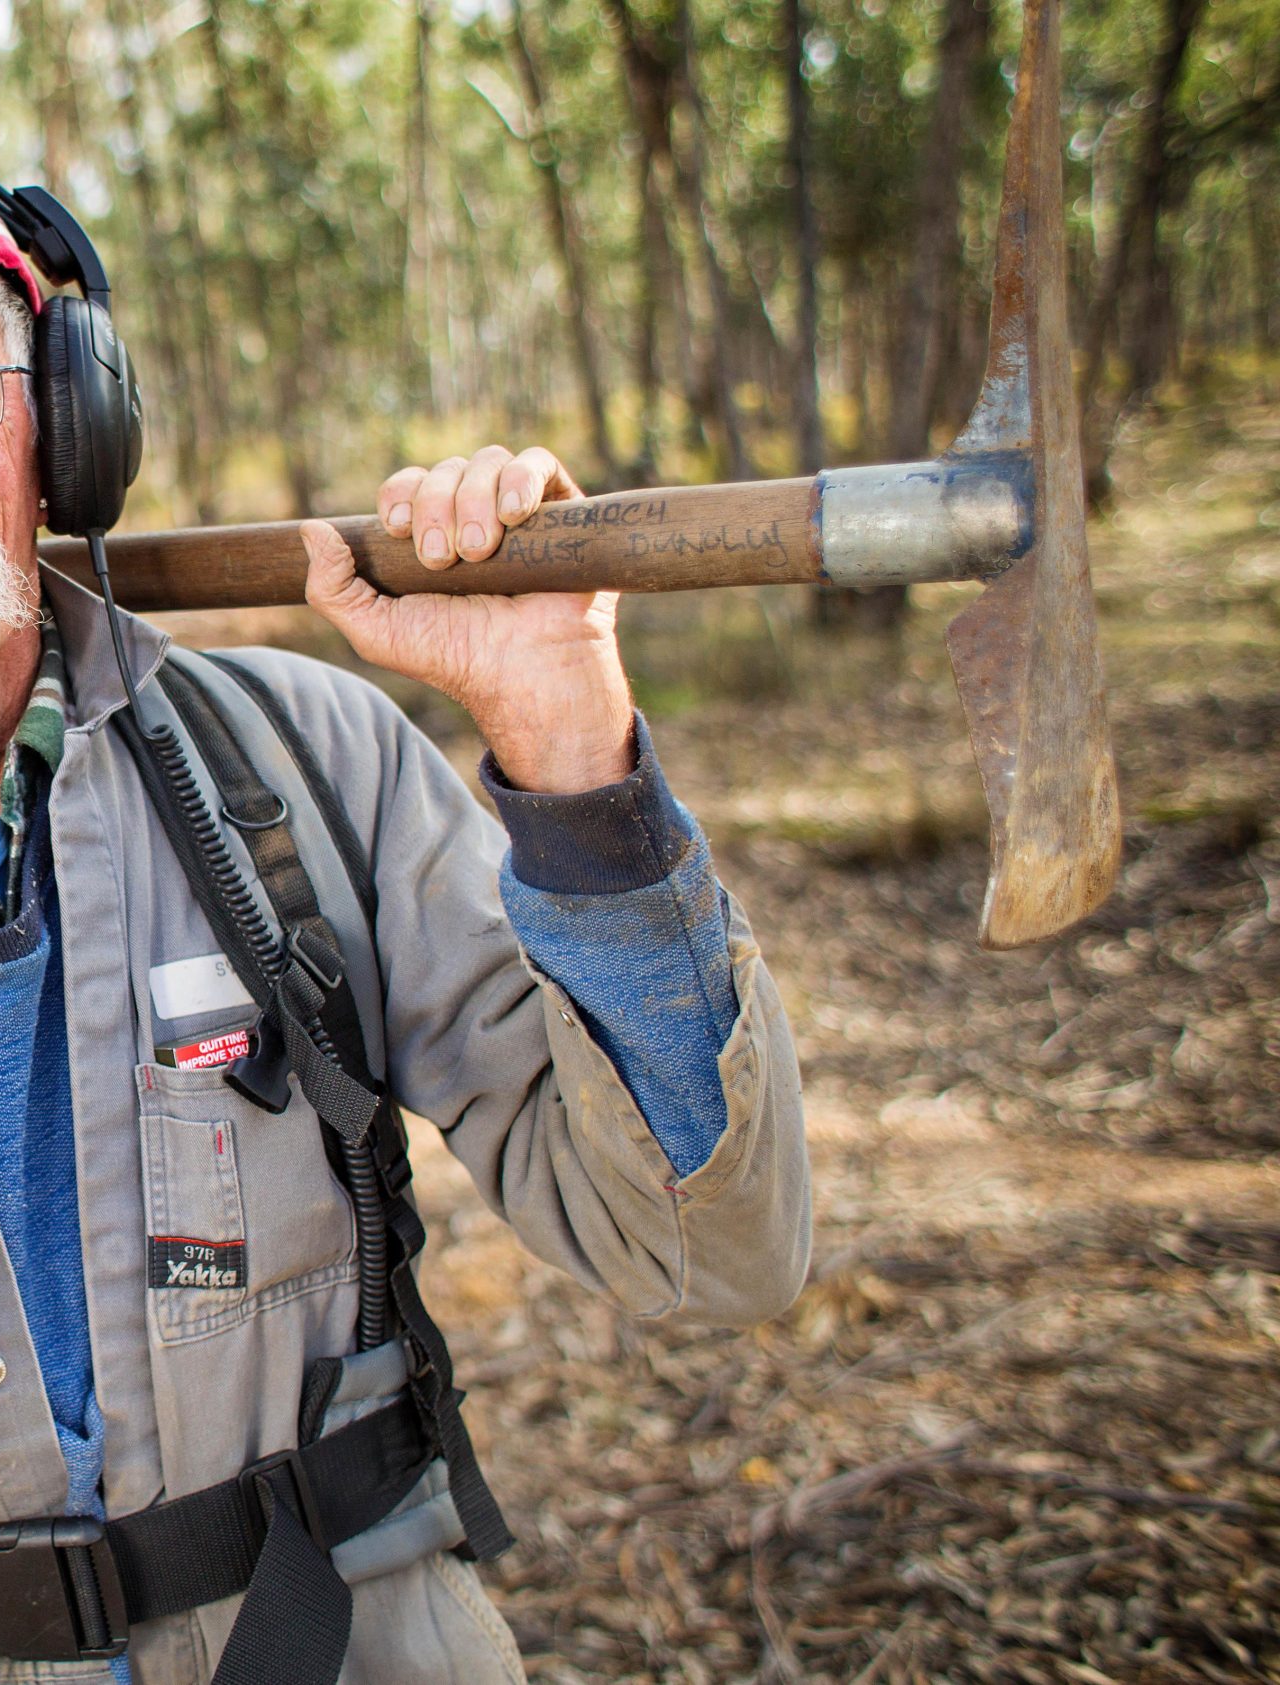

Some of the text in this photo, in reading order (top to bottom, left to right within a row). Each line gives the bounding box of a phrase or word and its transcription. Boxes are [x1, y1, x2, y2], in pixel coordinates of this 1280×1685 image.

[198, 1030, 248, 1053] QUITTING
[178, 1042, 249, 1071] IMPROVE YOU
[166, 1260, 237, 1286] Yakka
